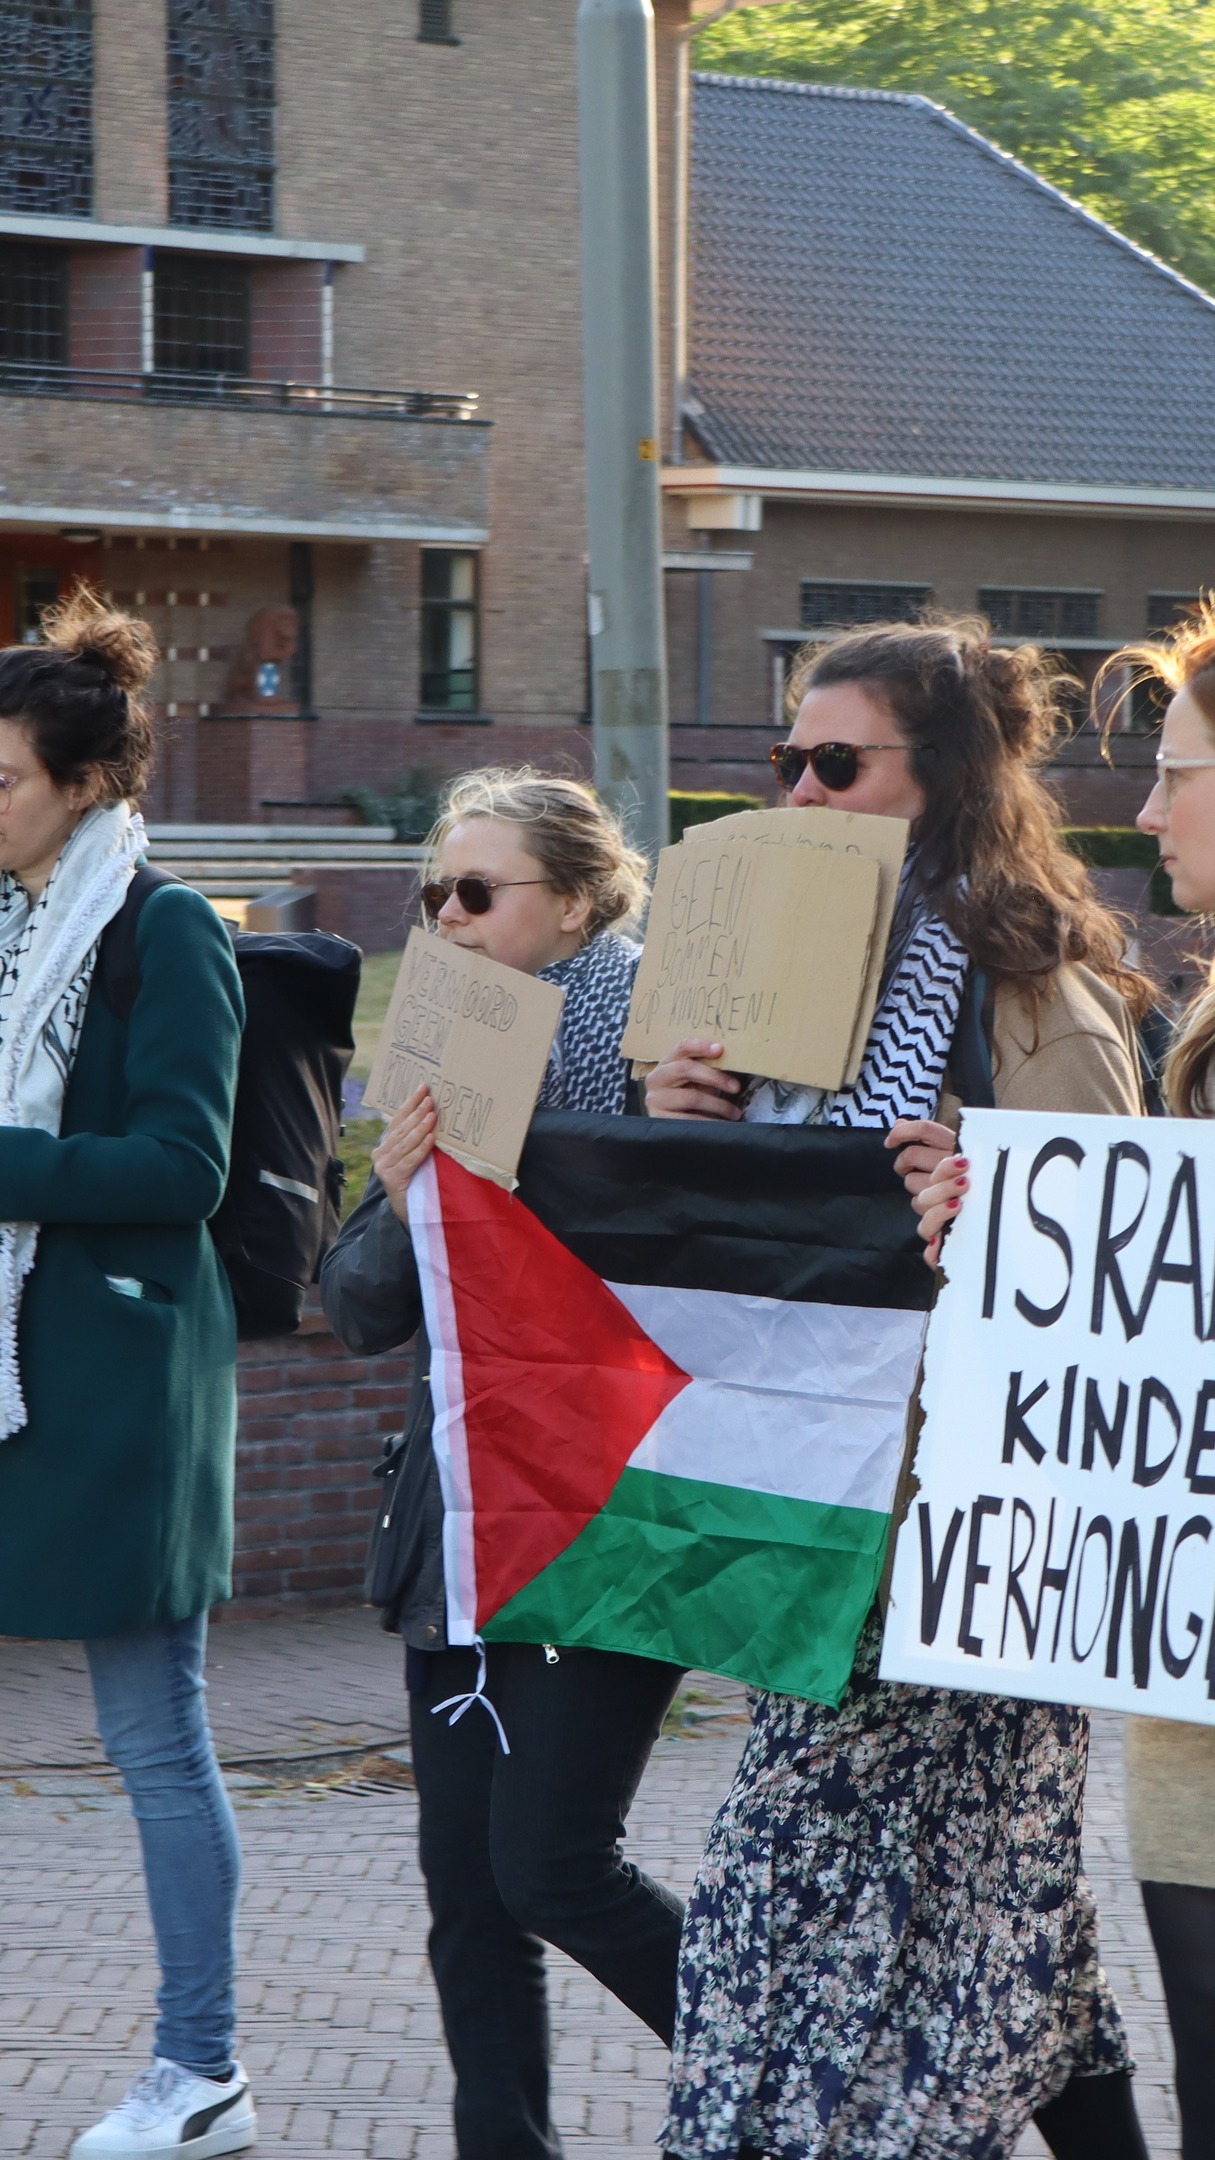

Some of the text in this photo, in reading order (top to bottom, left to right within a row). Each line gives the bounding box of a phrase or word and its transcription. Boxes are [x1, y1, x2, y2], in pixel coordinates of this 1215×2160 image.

[671, 854, 752, 935] GEEN
[393, 993, 454, 1062] GEEN
[407, 946, 519, 1033] VERMOORD
[635, 988, 660, 1035] OP
[981, 1136, 1215, 1342] ISRA
[918, 1494, 1215, 1700] VERHONG
